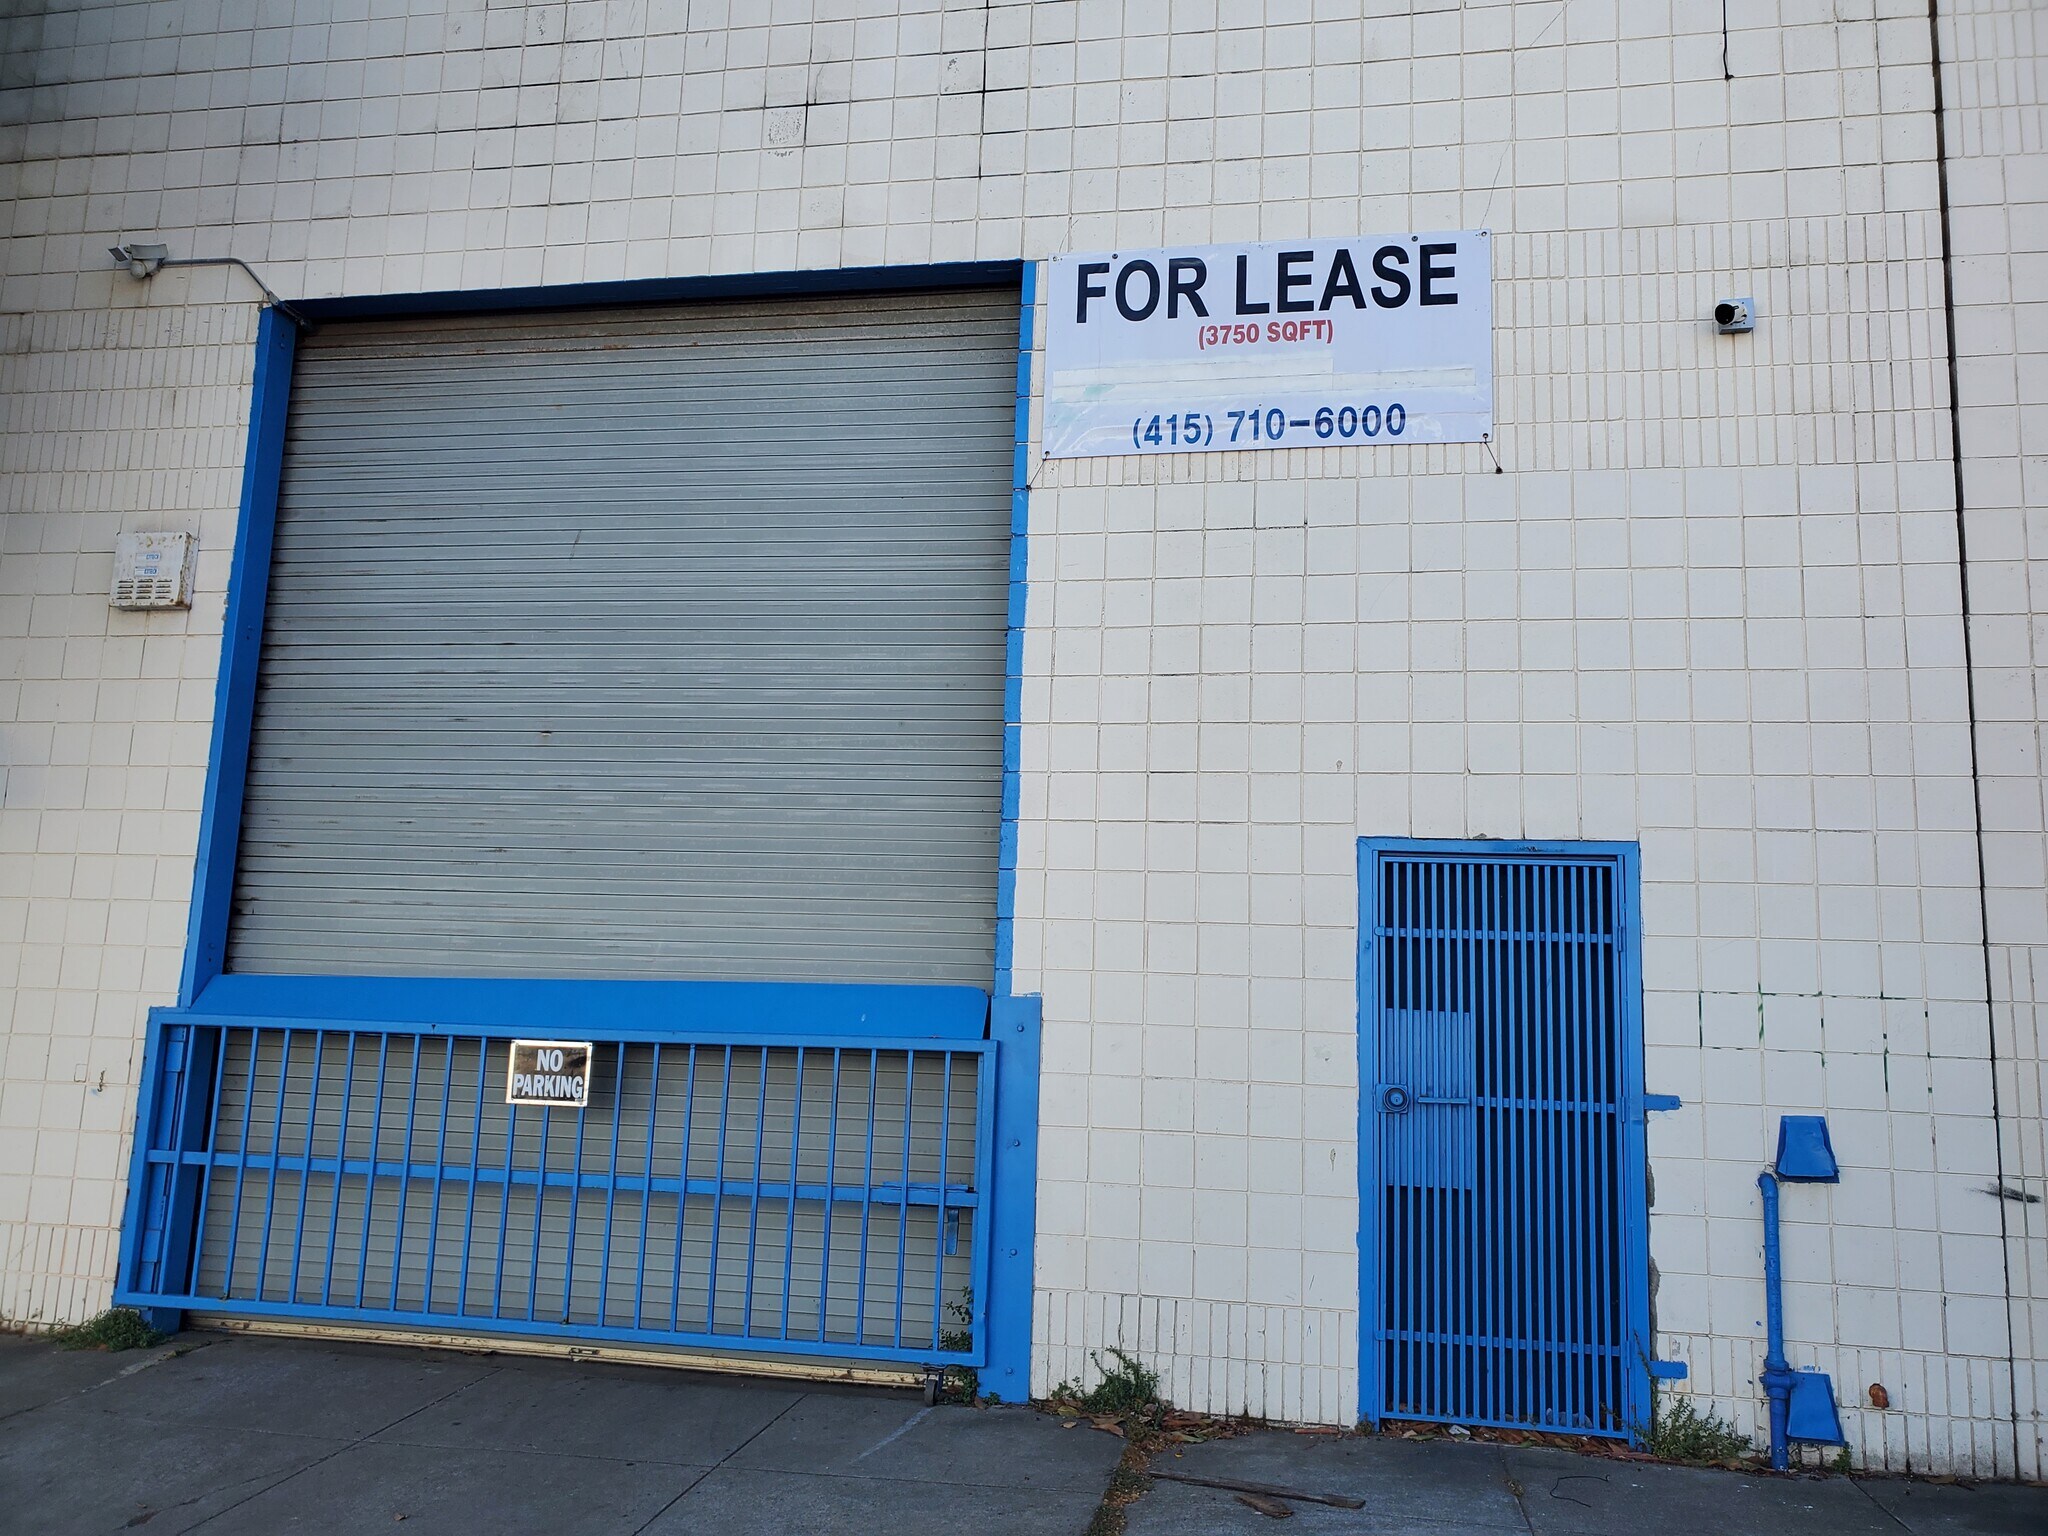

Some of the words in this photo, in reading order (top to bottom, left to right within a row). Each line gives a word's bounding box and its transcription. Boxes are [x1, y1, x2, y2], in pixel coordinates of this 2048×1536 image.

[1076, 257, 1209, 324] FOR
[1235, 243, 1458, 316] LEASE
[1198, 323, 1260, 350] (3750
[1267, 319, 1334, 344] SQFT)
[1132, 412, 1213, 449] (415)
[1226, 402, 1407, 443] 710-6000
[536, 1049, 564, 1072] NO
[512, 1073, 584, 1099] PARKING
